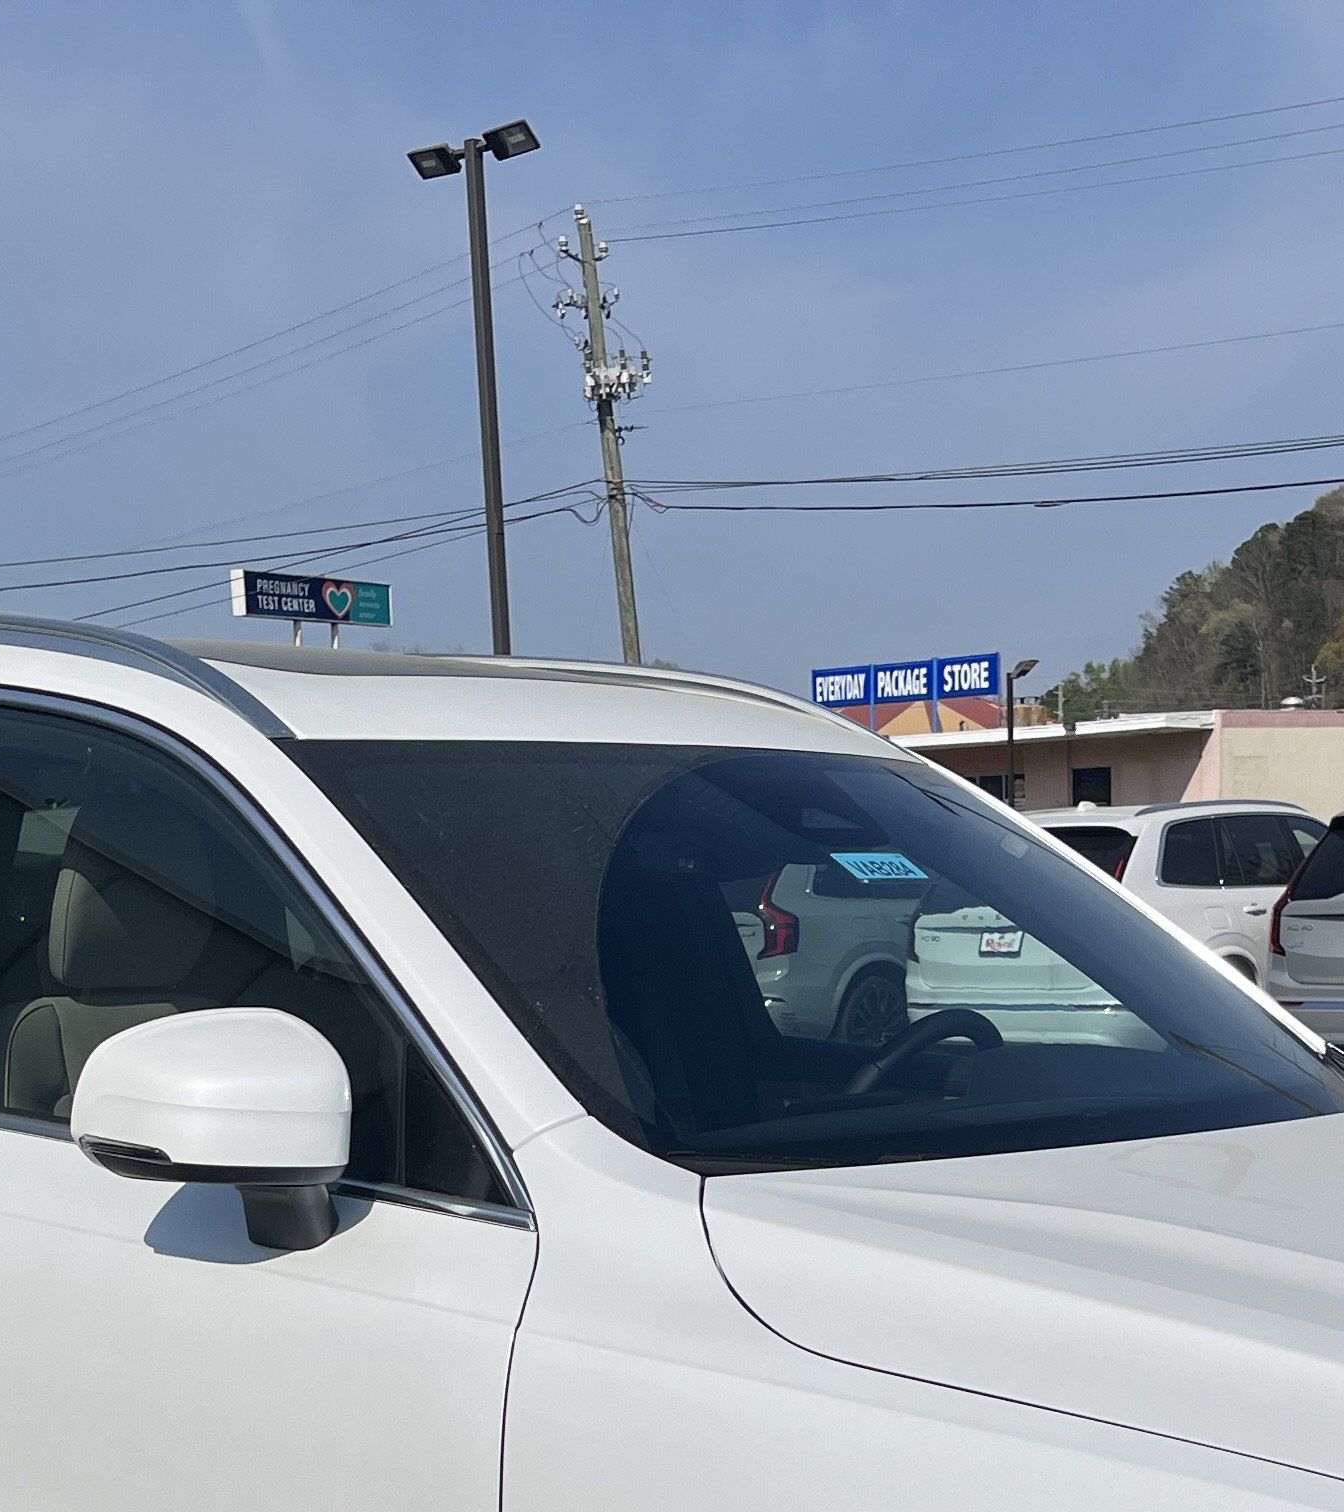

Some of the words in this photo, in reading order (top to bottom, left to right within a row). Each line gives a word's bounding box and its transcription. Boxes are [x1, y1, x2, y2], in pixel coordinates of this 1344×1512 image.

[256, 578, 310, 597] PREGNANCY
[257, 595, 279, 610] TEST
[281, 597, 316, 613] CENTER
[815, 673, 866, 703] EVERYDAY
[877, 667, 928, 698] PACKAGE
[943, 661, 990, 693] STORE
